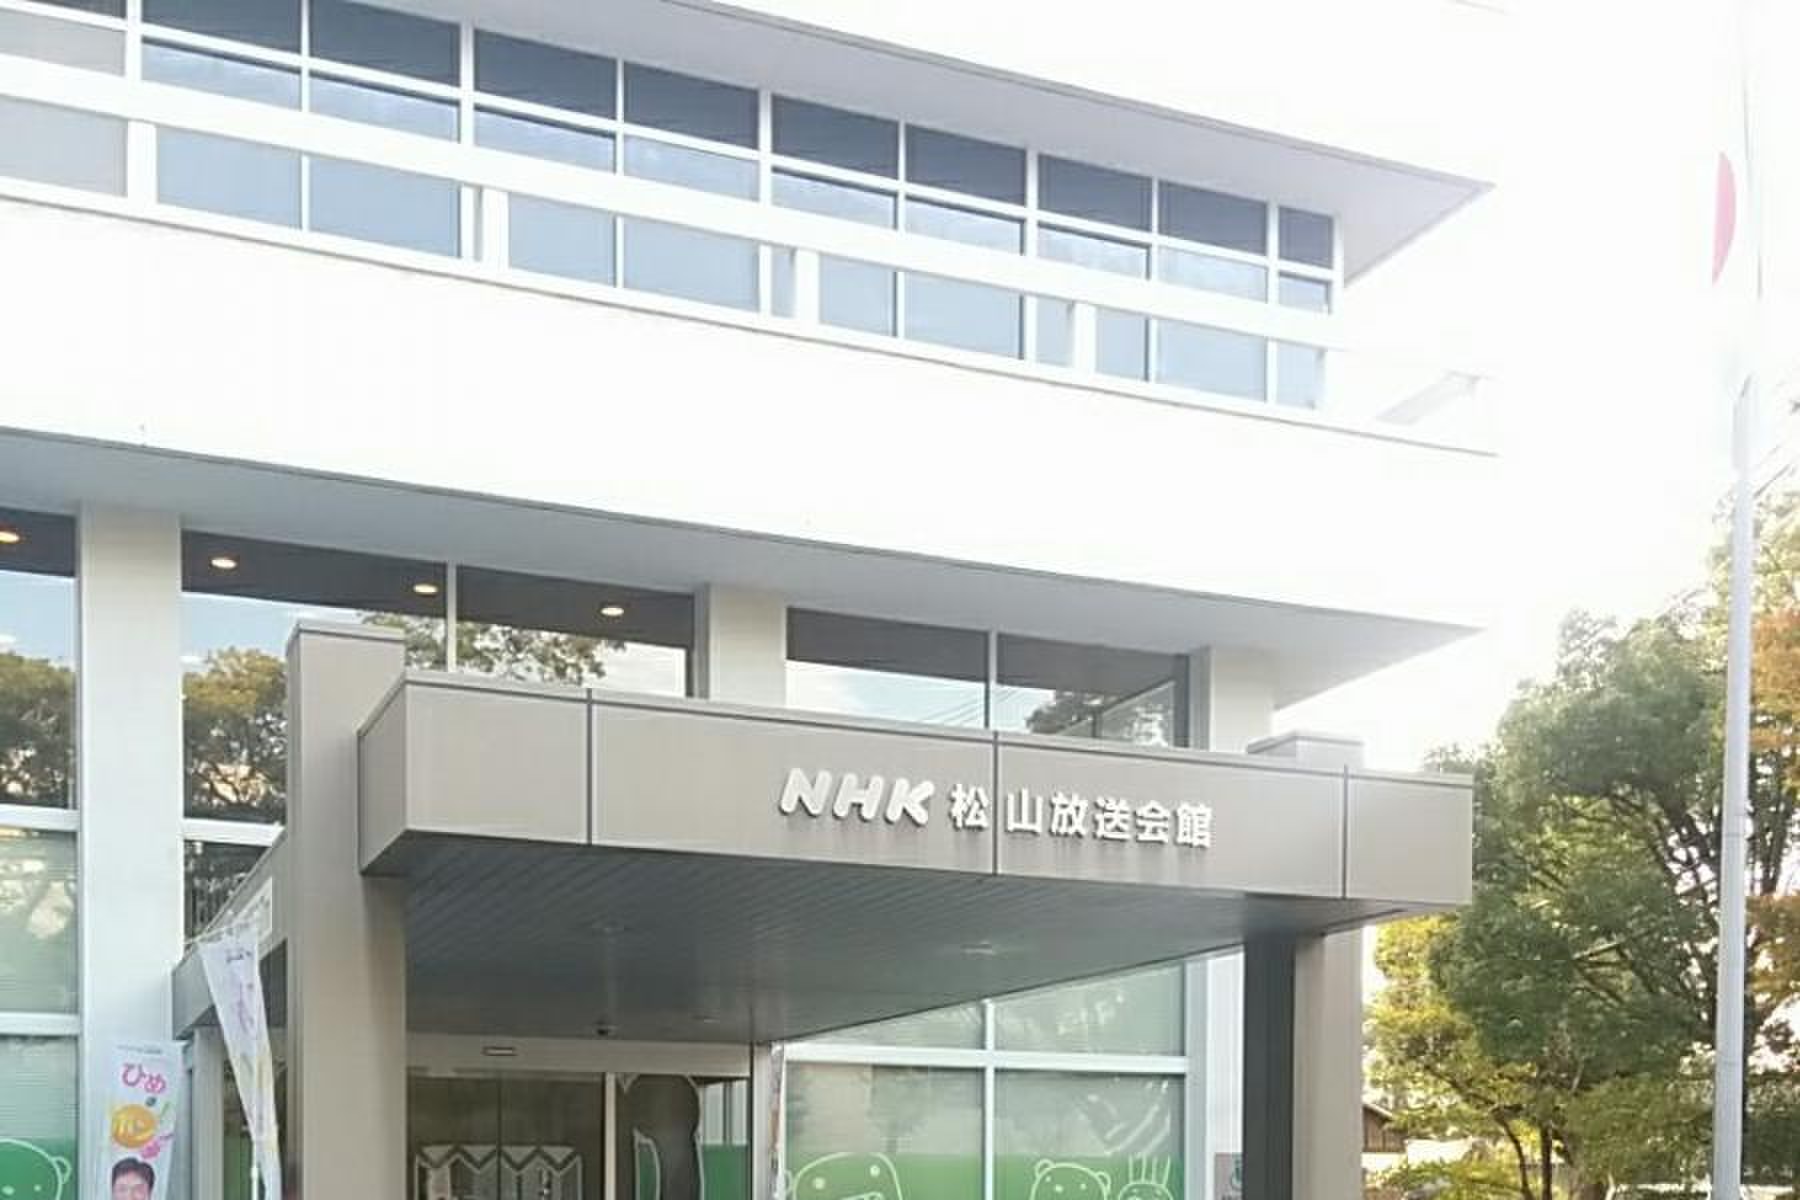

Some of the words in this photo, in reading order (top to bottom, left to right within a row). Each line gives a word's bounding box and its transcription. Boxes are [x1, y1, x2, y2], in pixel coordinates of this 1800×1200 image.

[779, 768, 934, 824] NHK
[950, 784, 1213, 848] 松山放送会館
